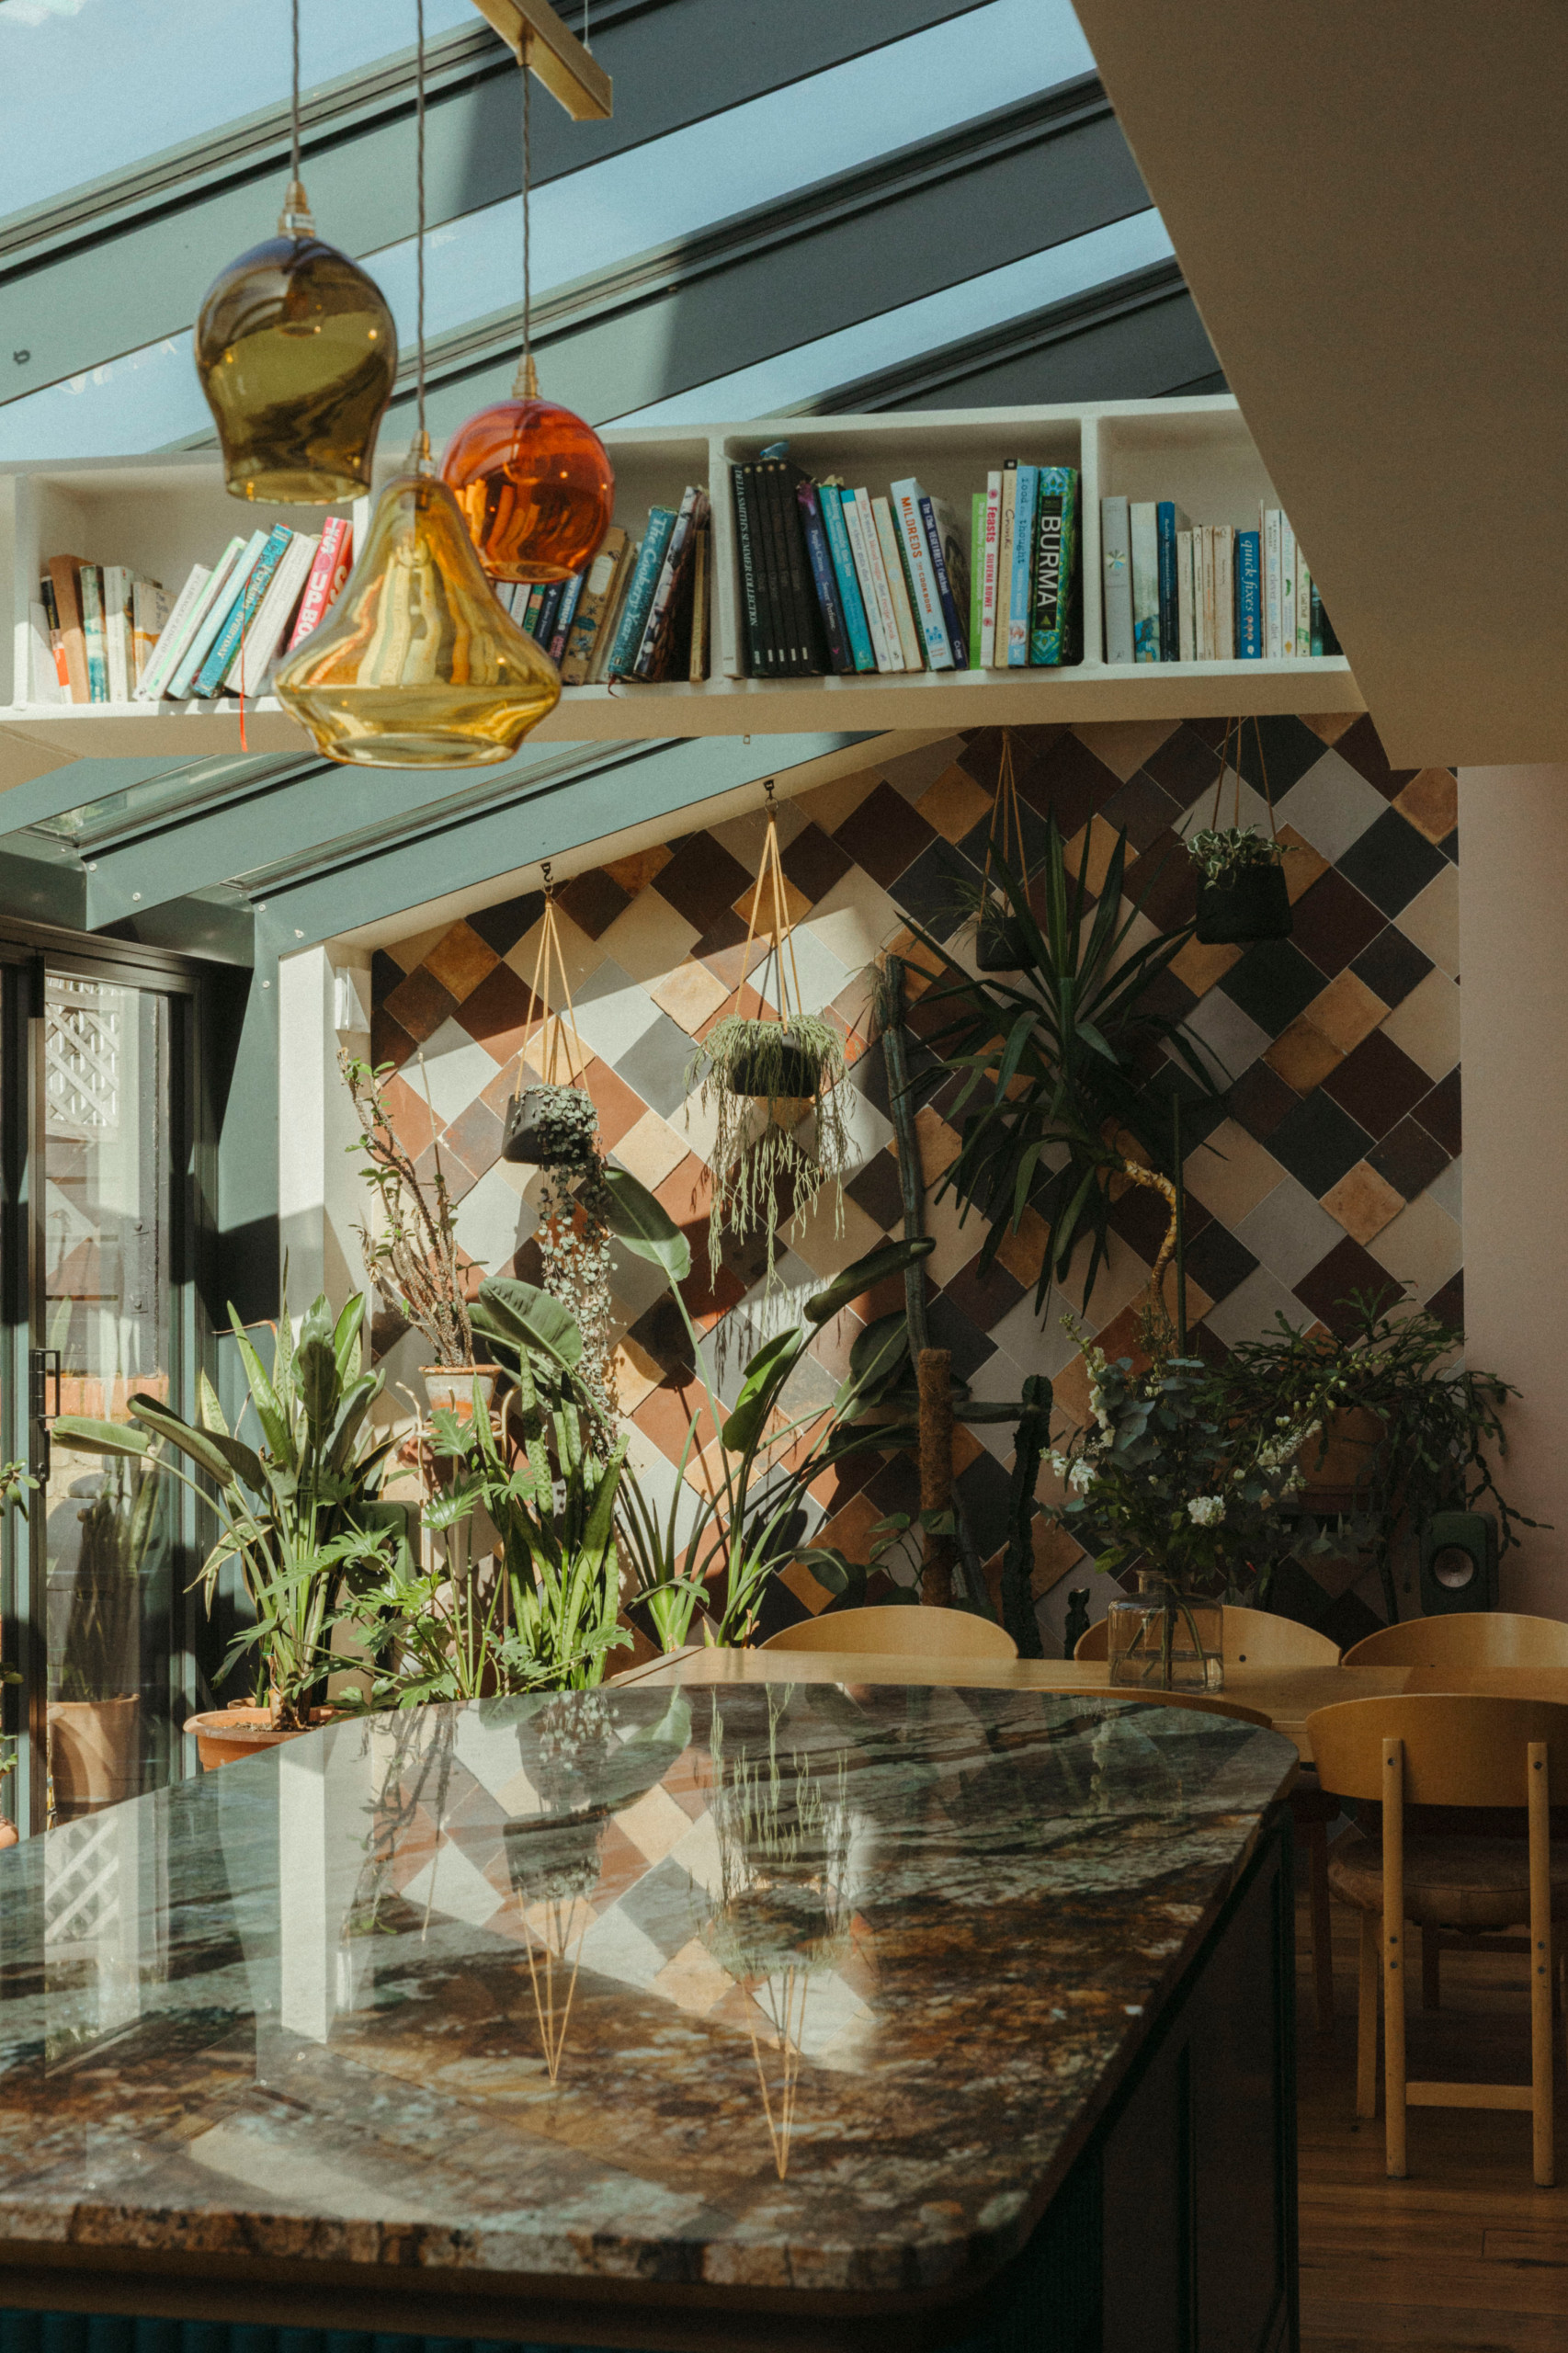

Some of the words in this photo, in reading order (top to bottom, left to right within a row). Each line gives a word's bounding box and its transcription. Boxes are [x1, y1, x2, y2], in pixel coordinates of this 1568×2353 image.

[733, 468, 744, 496] DELIA
[1019, 476, 1030, 504] food
[736, 495, 748, 532] SMITH'S
[826, 488, 841, 520] Cooking
[859, 499, 869, 513] the
[646, 515, 668, 546] The
[834, 520, 846, 549] outside
[975, 516, 984, 545] Healthy
[984, 506, 997, 543] Feasts
[740, 531, 752, 572] SUMMER
[809, 529, 822, 551] Purple
[840, 548, 849, 562] the
[868, 539, 879, 561] blood
[900, 495, 923, 559] MILDREDS
[917, 571, 933, 614] COOKBOOK
[922, 502, 931, 515] The
[927, 529, 943, 568] VEGETABLES
[936, 567, 949, 596] Cookbook
[1015, 518, 1028, 564] thought
[843, 563, 853, 577] box
[852, 529, 863, 551] clever
[860, 567, 870, 582] diet
[984, 552, 994, 583] SILVENA
[1036, 515, 1062, 608] BURMA
[1240, 540, 1256, 577] quick
[1268, 557, 1277, 572] the
[626, 546, 660, 610] Cookery
[871, 561, 882, 582] sugar
[975, 561, 983, 601] Handbook
[1268, 574, 1278, 599] clever
[744, 572, 757, 626] COLLECTION
[820, 580, 832, 601] Sweet
[877, 582, 887, 597] diet
[983, 585, 993, 608] ROWE
[1240, 576, 1258, 612] fixes
[824, 601, 837, 631] Perfume
[879, 597, 892, 620] recipe
[1267, 602, 1276, 621] guts
[215, 608, 246, 660] EVERYDAY
[619, 609, 641, 642] Year
[885, 620, 896, 640] book
